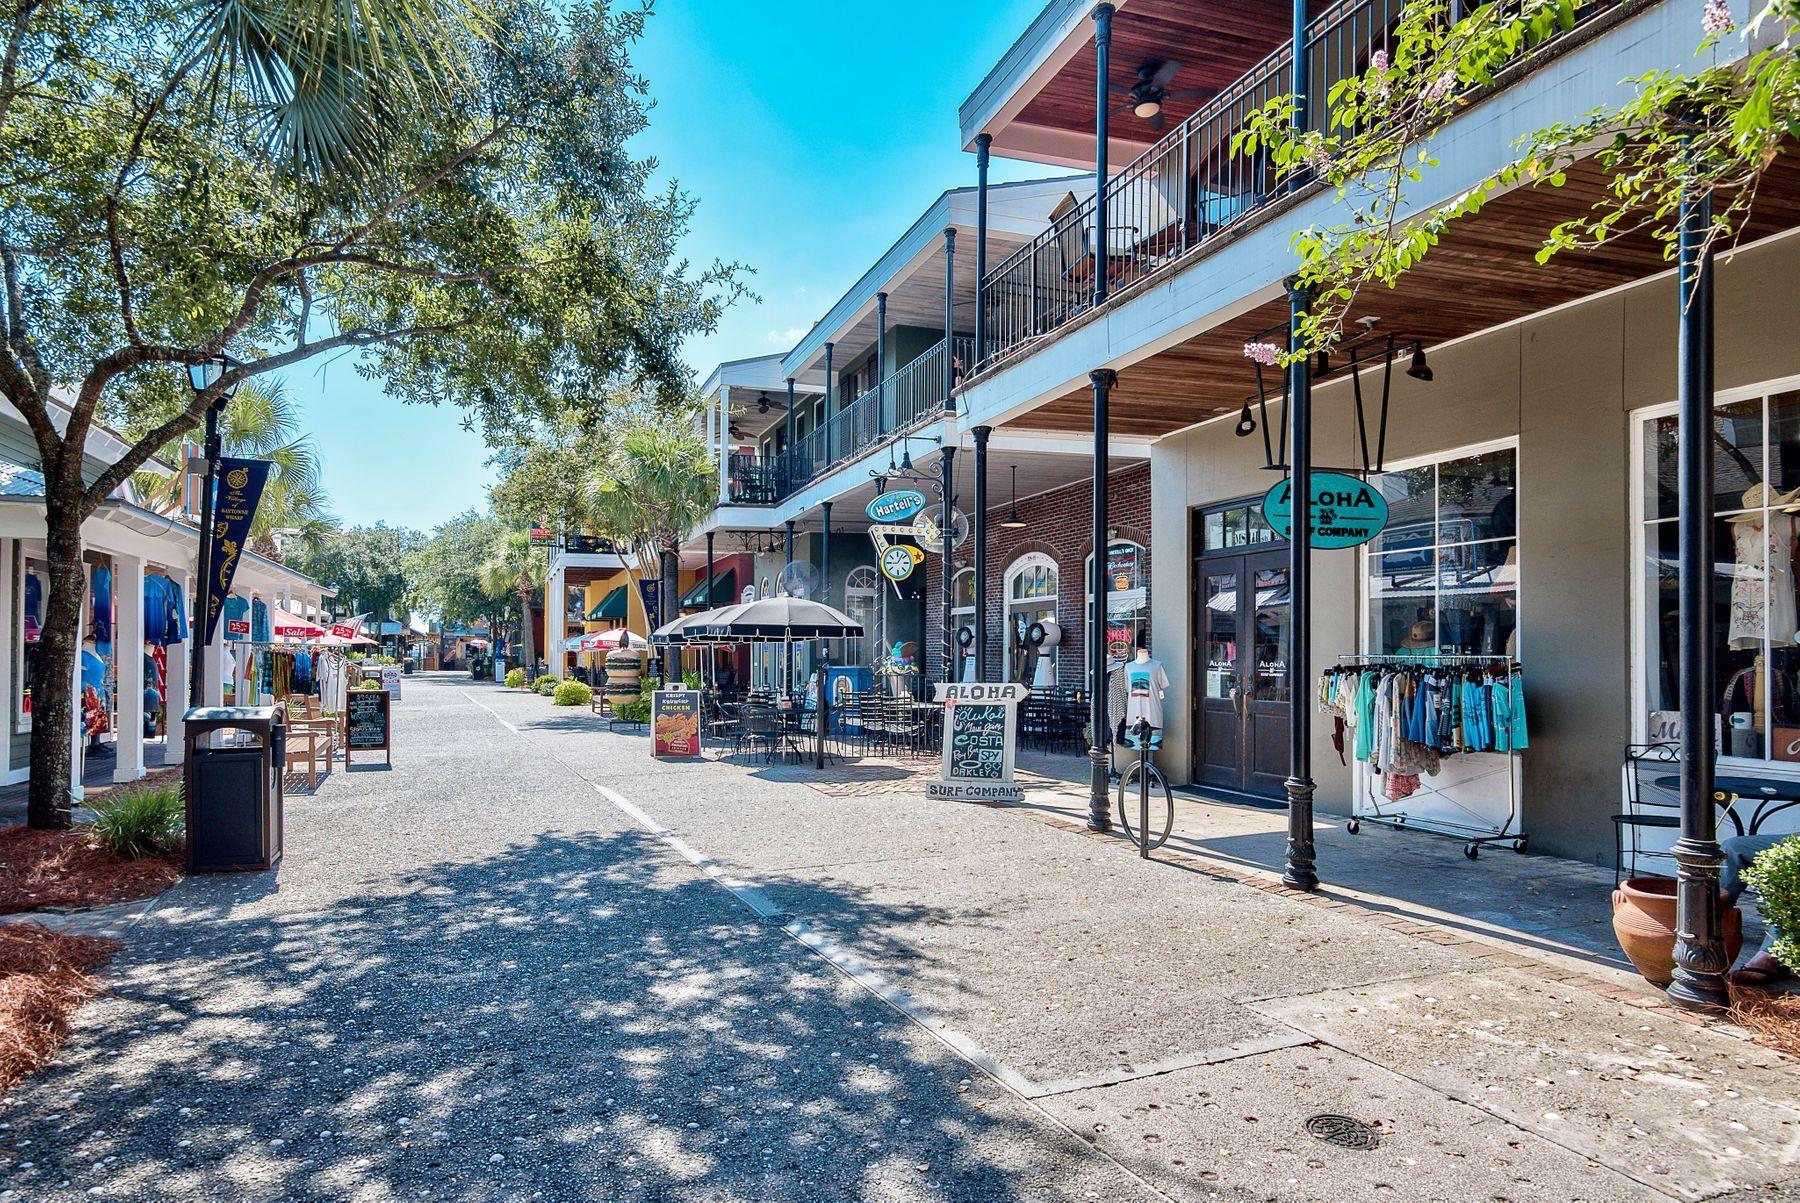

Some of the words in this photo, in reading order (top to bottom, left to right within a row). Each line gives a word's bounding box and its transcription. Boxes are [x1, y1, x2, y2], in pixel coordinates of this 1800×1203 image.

[875, 496, 921, 517] Hartell's
[1317, 526, 1370, 538] COMPANY
[284, 627, 305, 638] Sale
[1259, 660, 1286, 668] ALOHA
[946, 685, 1016, 700] ALOHA
[954, 735, 1003, 747] COSTA
[981, 751, 1000, 761] SPY
[952, 767, 992, 777] OAKLEY
[929, 784, 963, 797] SURF
[965, 785, 1020, 797] COMPANY
